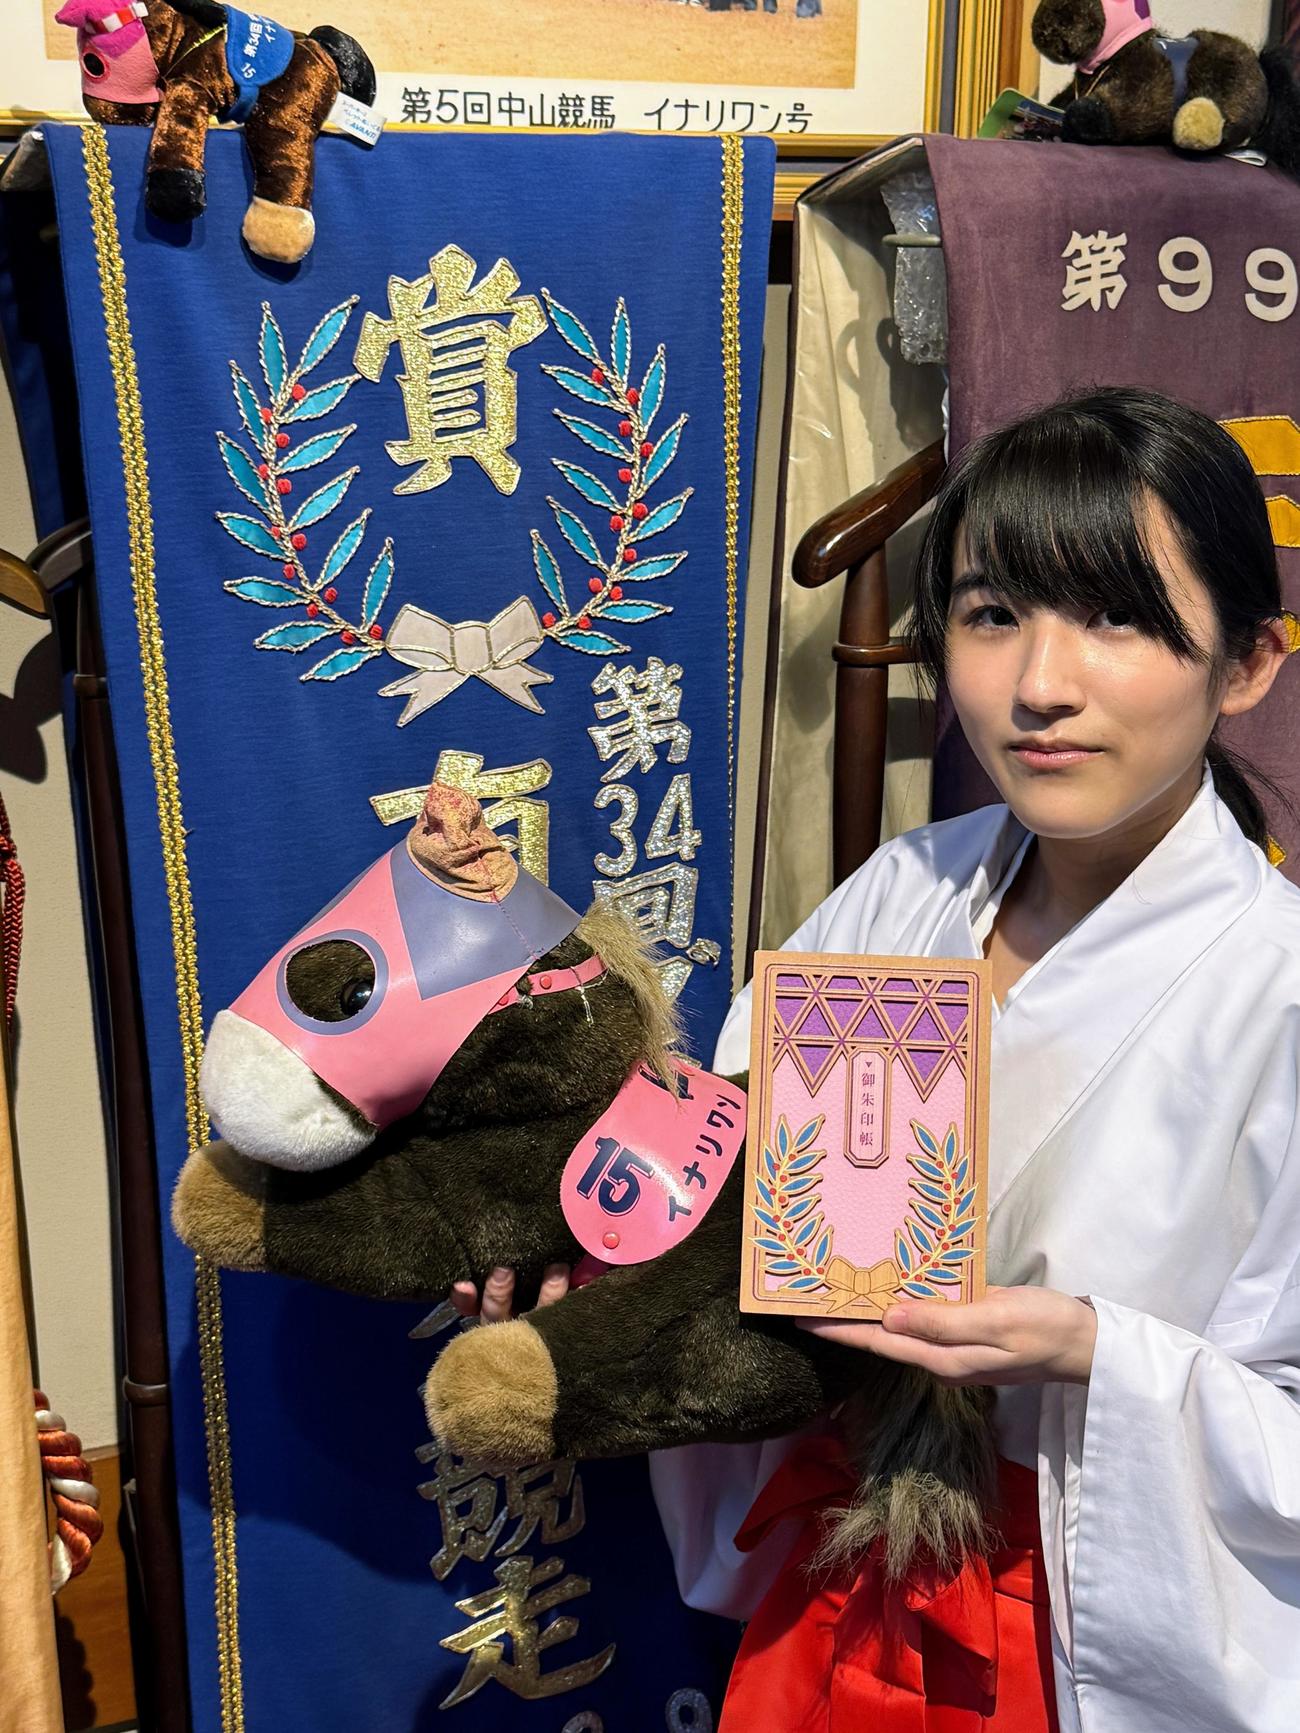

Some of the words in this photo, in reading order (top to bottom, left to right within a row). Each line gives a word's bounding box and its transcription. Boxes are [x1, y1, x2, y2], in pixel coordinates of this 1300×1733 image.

[240, 62, 257, 79] 15
[400, 86, 616, 128] 第5回中山競馬
[643, 97, 814, 134] イナリワン号
[352, 243, 549, 496] 賞
[859, 1072, 876, 1147] 御朱印帳
[576, 1136, 656, 1217] 15
[668, 1093, 742, 1222] イナリワン
